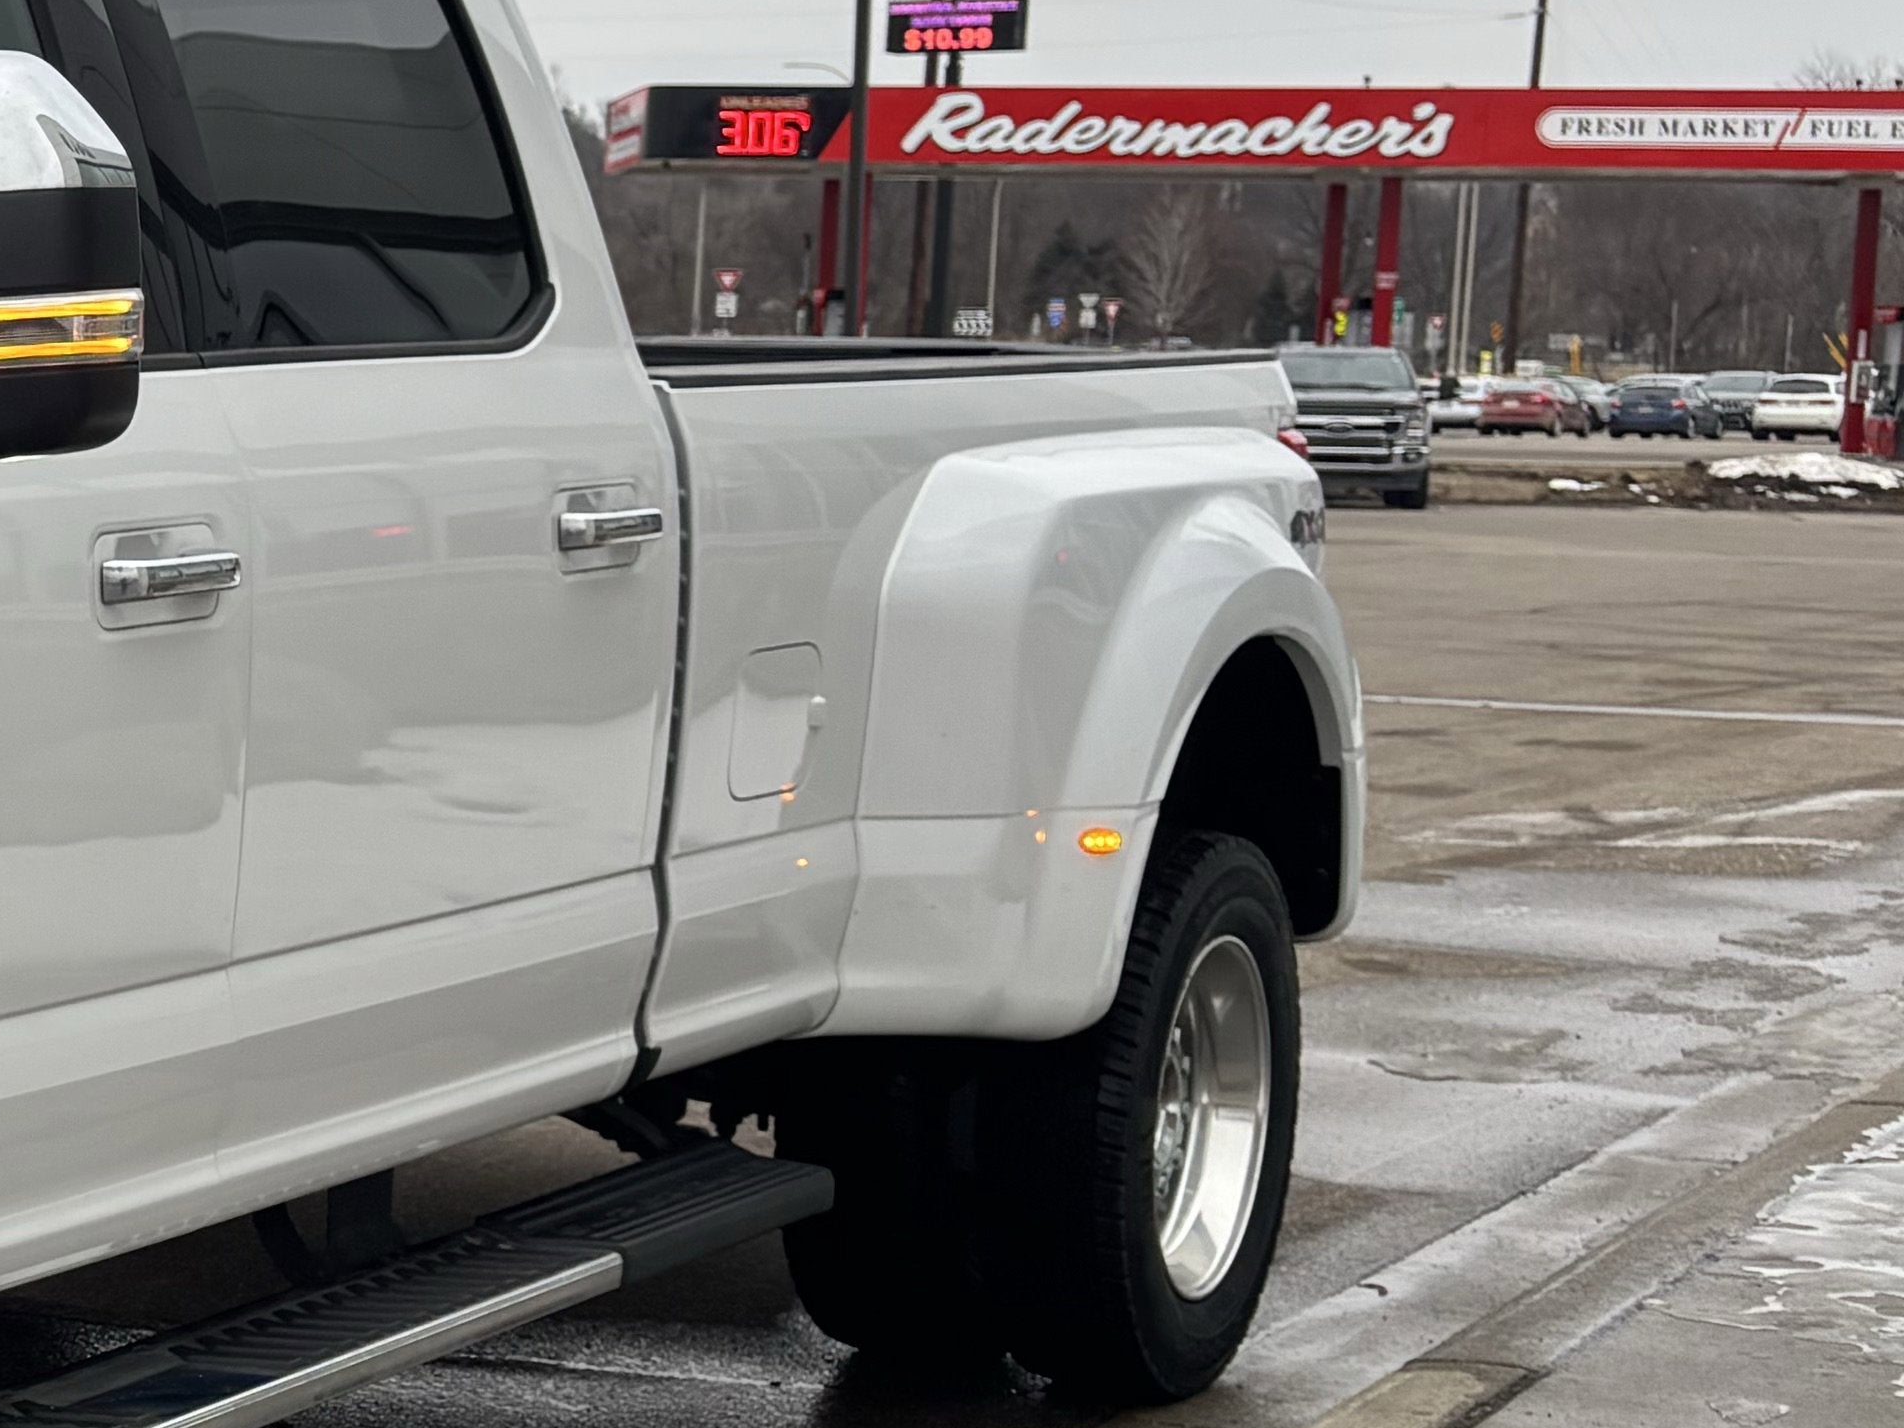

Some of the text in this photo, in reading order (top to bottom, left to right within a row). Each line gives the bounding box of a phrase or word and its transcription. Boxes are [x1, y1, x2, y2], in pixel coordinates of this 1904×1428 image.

[901, 92, 1455, 159] Radermacher's
[1560, 116, 1645, 138] FRESH
[1658, 118, 1775, 139] MARKET
[1810, 120, 1878, 140] FUEL
